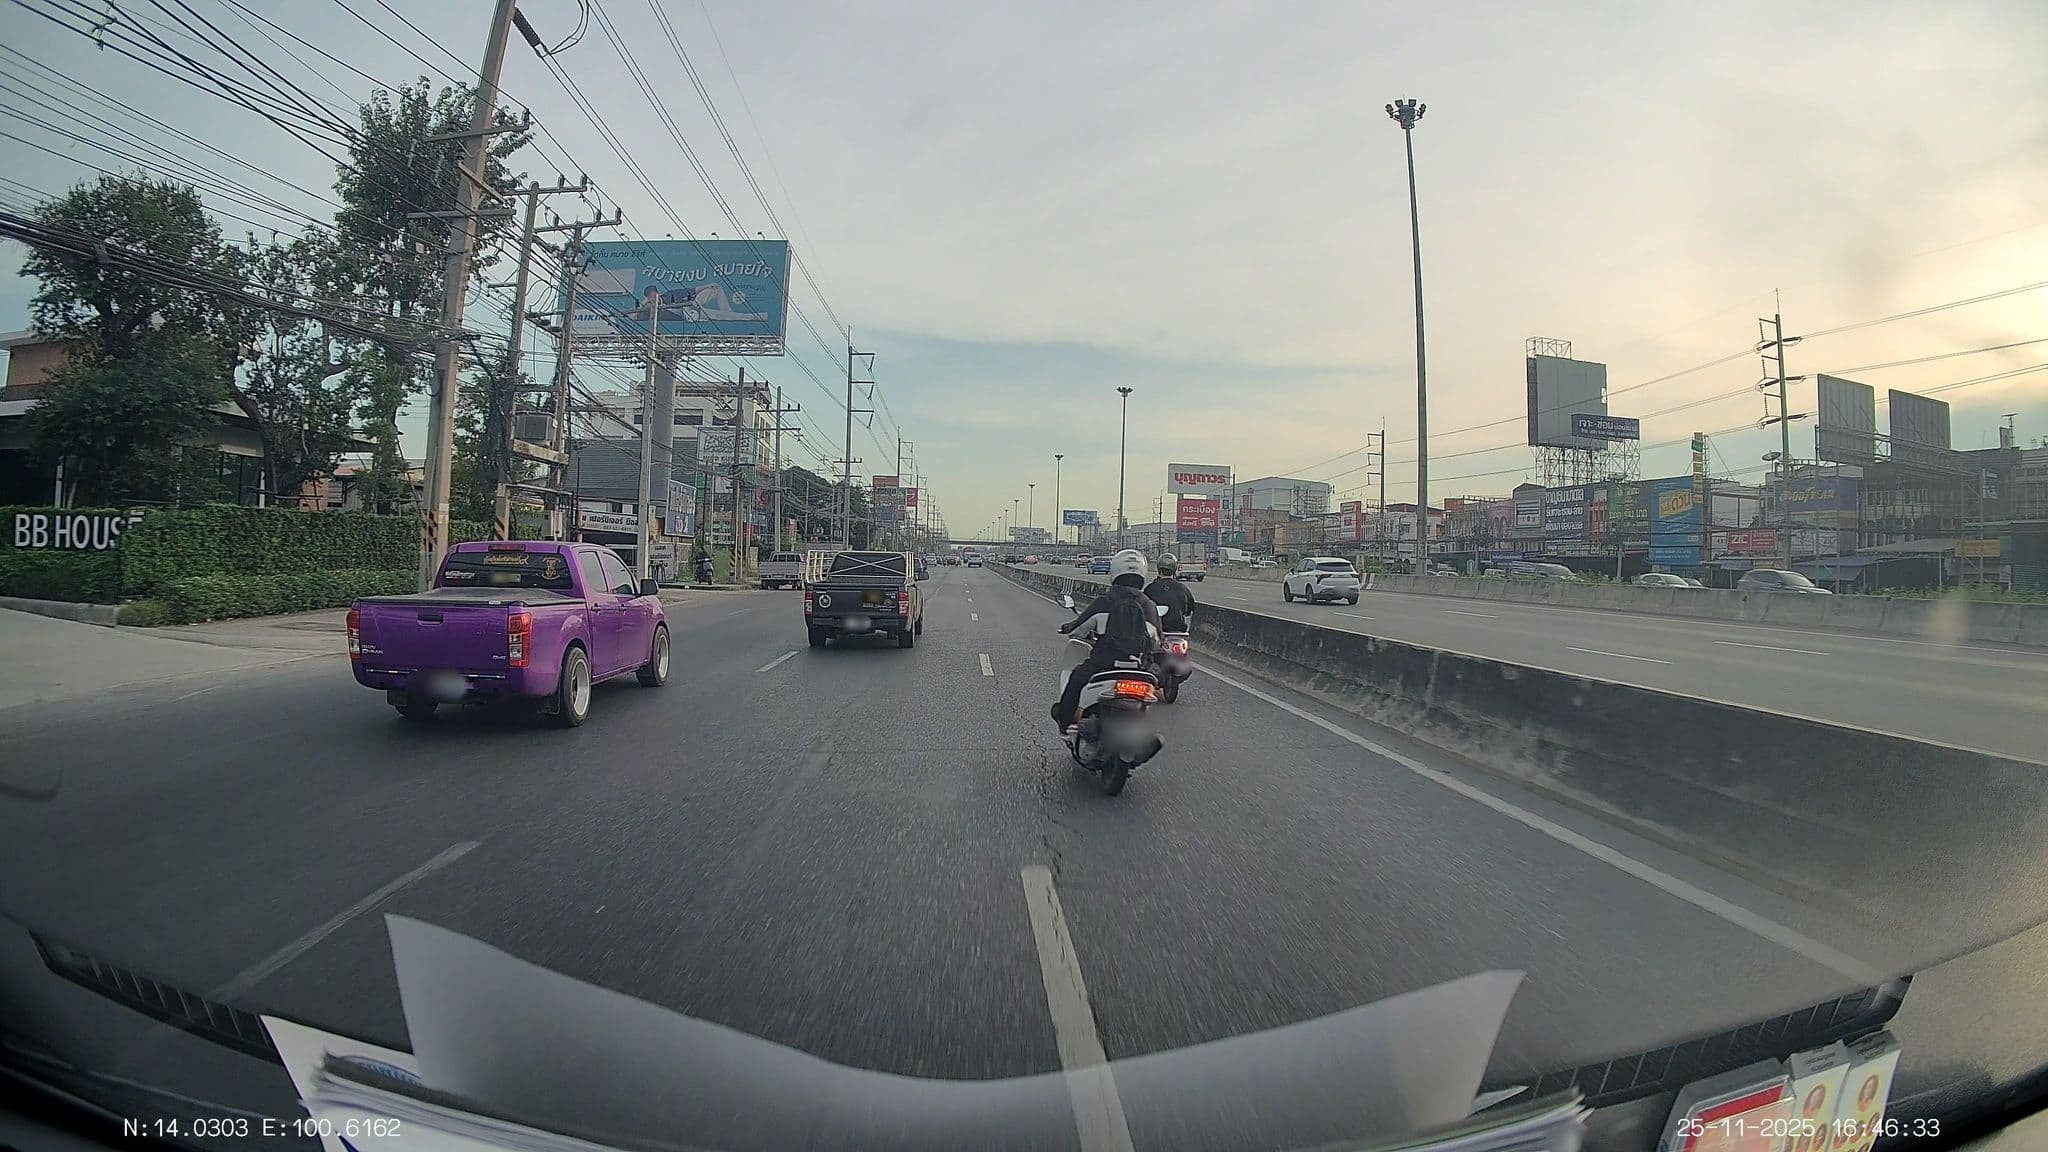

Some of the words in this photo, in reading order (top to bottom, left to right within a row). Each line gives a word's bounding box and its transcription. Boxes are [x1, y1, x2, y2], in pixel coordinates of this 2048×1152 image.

[1174, 472, 1226, 485] บุญถาวร
[14, 513, 49, 548] BB
